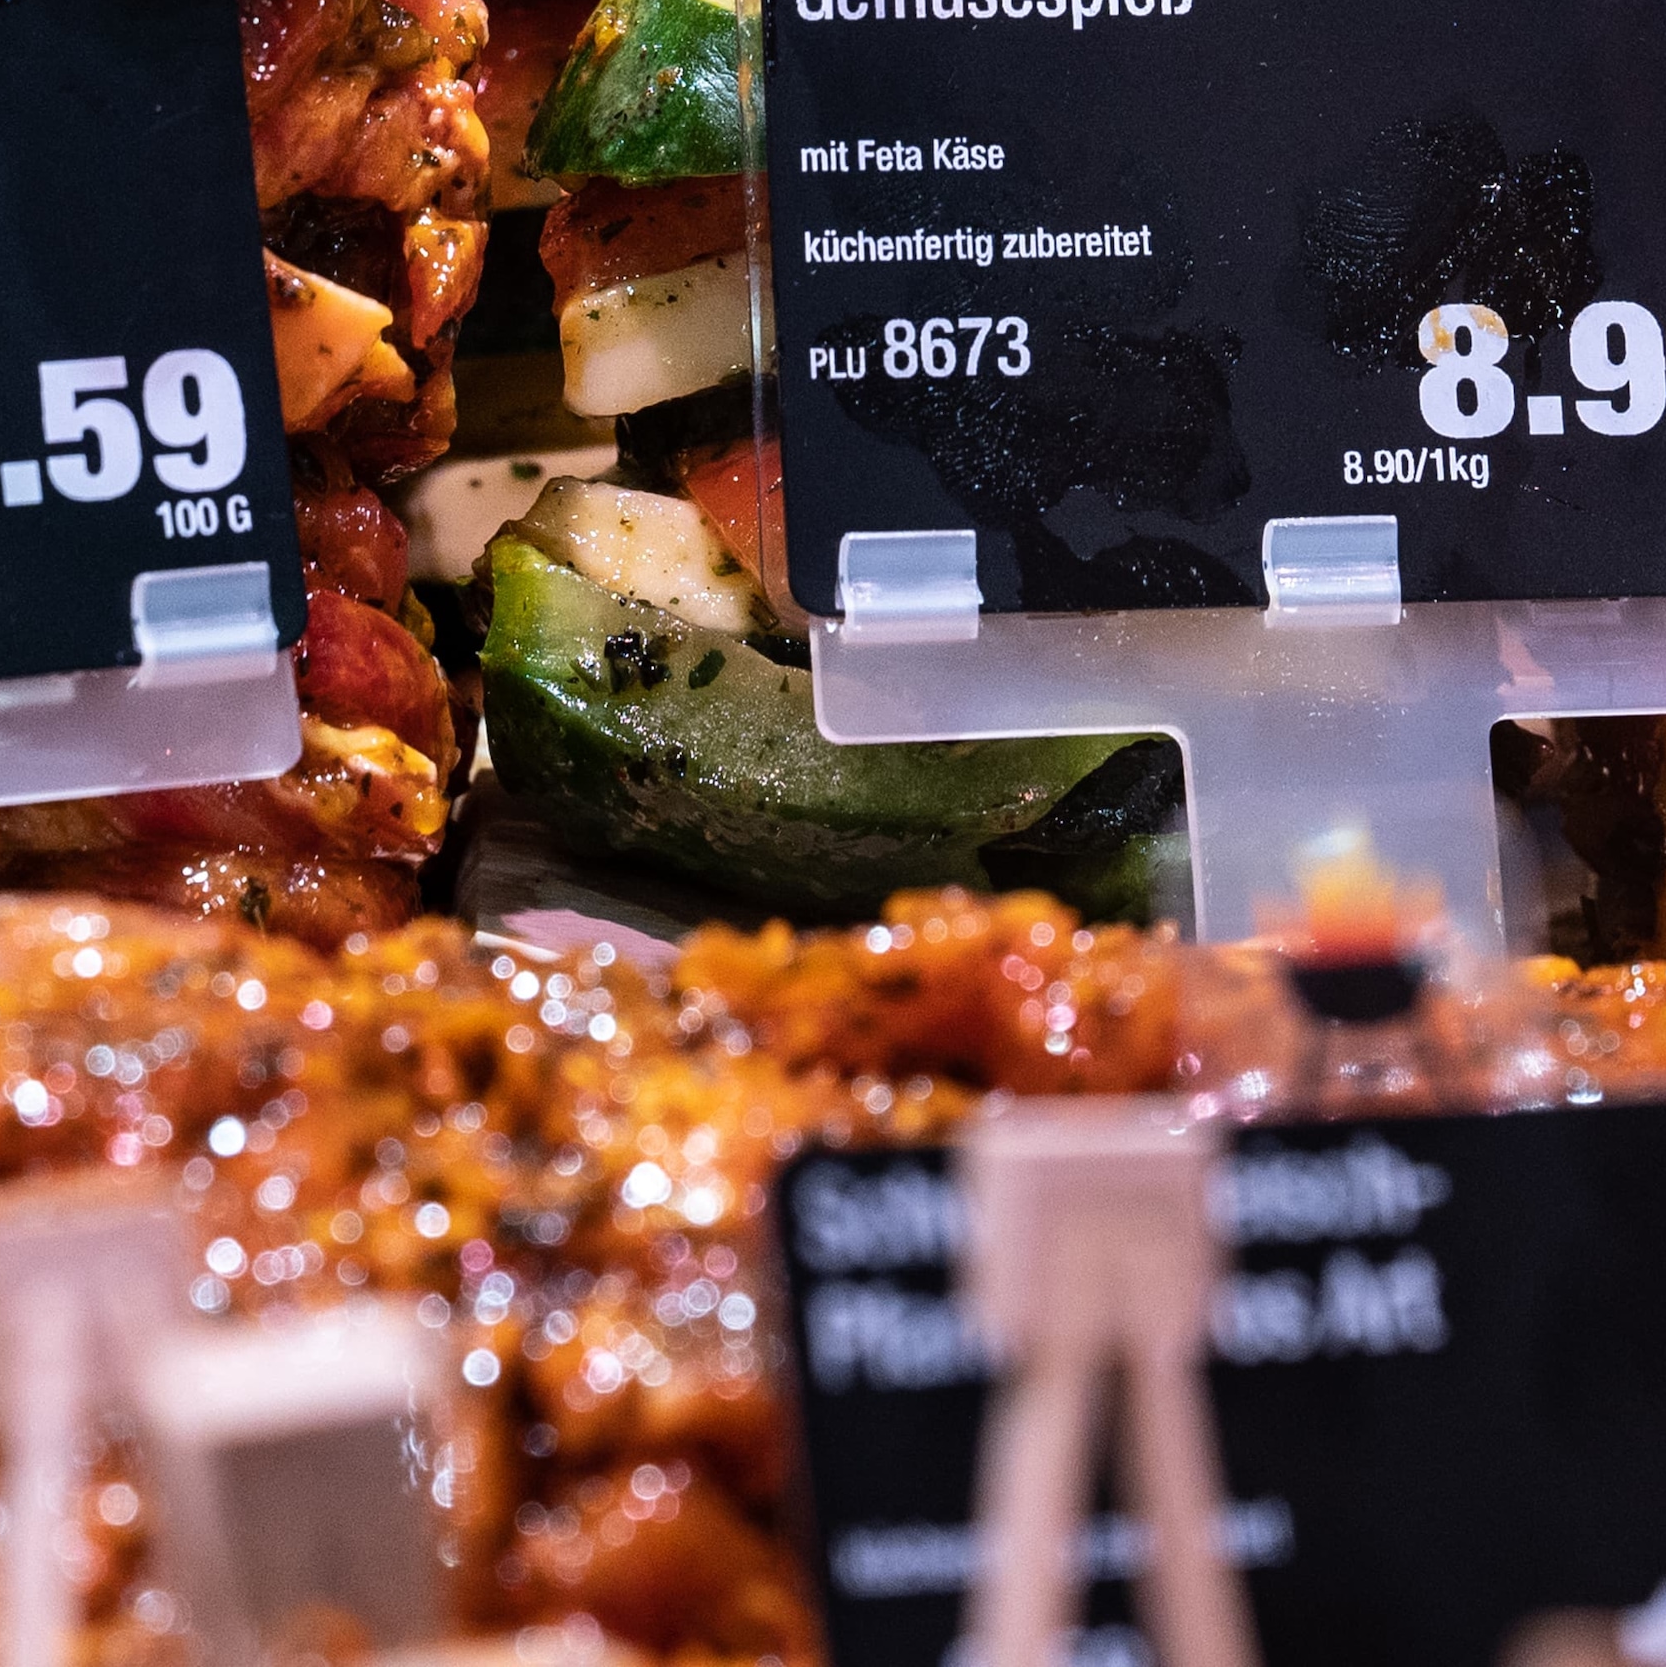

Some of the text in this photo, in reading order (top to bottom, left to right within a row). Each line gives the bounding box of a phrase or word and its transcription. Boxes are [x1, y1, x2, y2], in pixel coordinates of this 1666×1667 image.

[800, 137, 1006, 173] mit Feta Käse
[804, 223, 1153, 268] küchenfertig zubereitet
[809, 316, 1031, 380] PLU 8673
[1343, 446, 1490, 490] 8.90/1kg
[156, 494, 253, 538] 100 G
